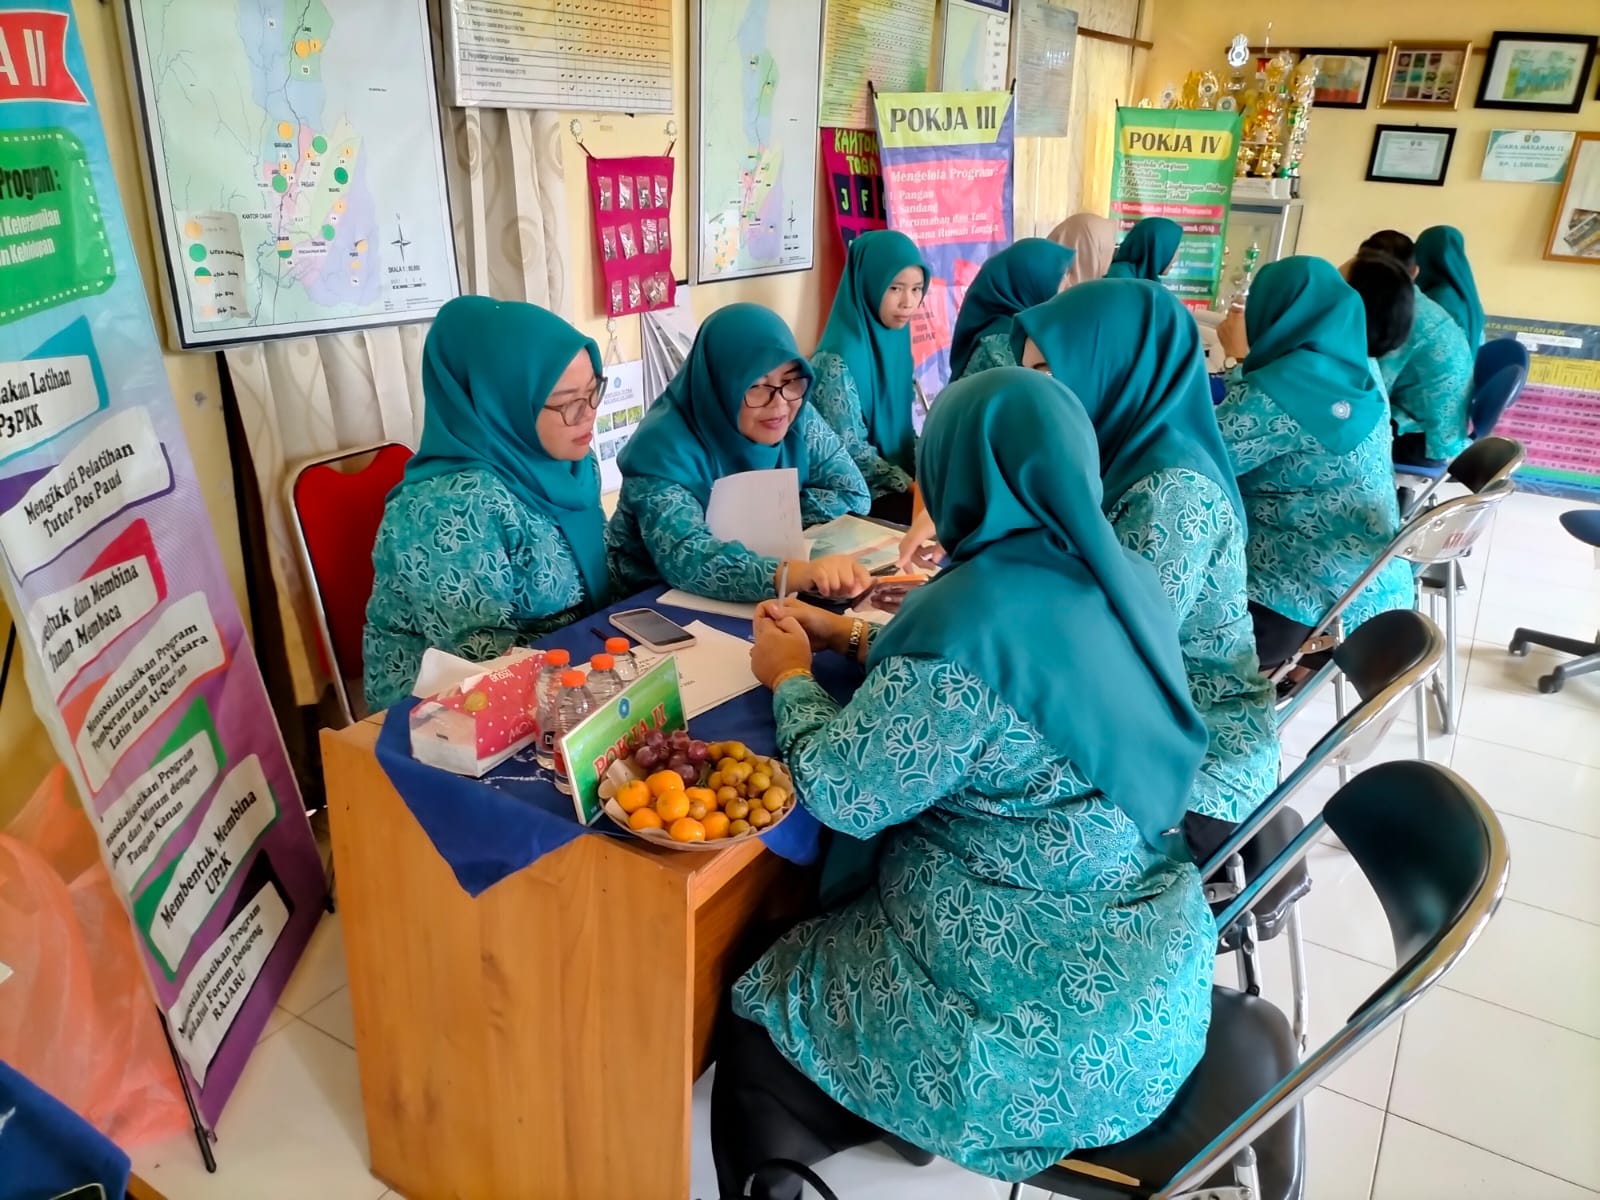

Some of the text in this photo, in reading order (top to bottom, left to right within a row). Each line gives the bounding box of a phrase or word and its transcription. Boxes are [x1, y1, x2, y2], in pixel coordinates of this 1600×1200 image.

[23, 29, 47, 87] II
[890, 105, 997, 133] POKJA III
[1129, 131, 1222, 154] POKJA IV
[890, 169, 947, 184] Mengelola
[29, 367, 72, 396] Latihan
[24, 443, 135, 525] Mengikuti Pelatihan
[74, 491, 95, 514] Pos
[93, 468, 122, 500] Paud
[74, 596, 92, 618] dan
[90, 564, 139, 606] Membina
[75, 604, 122, 649] Membaca
[155, 623, 199, 661] Program
[147, 663, 171, 688] Buta
[169, 634, 209, 666] Aksara
[108, 721, 133, 751] Latin
[131, 703, 150, 725] dan
[157, 747, 195, 785] Program
[126, 822, 143, 844] dan
[139, 792, 170, 827] Minum
[169, 763, 199, 796] dengan
[126, 800, 184, 866] Tangan Kanan
[159, 790, 258, 930] Membentuk, Membina
[228, 903, 262, 947] Program
[205, 966, 235, 1005] Forum
[211, 968, 248, 1022] RAJARU
